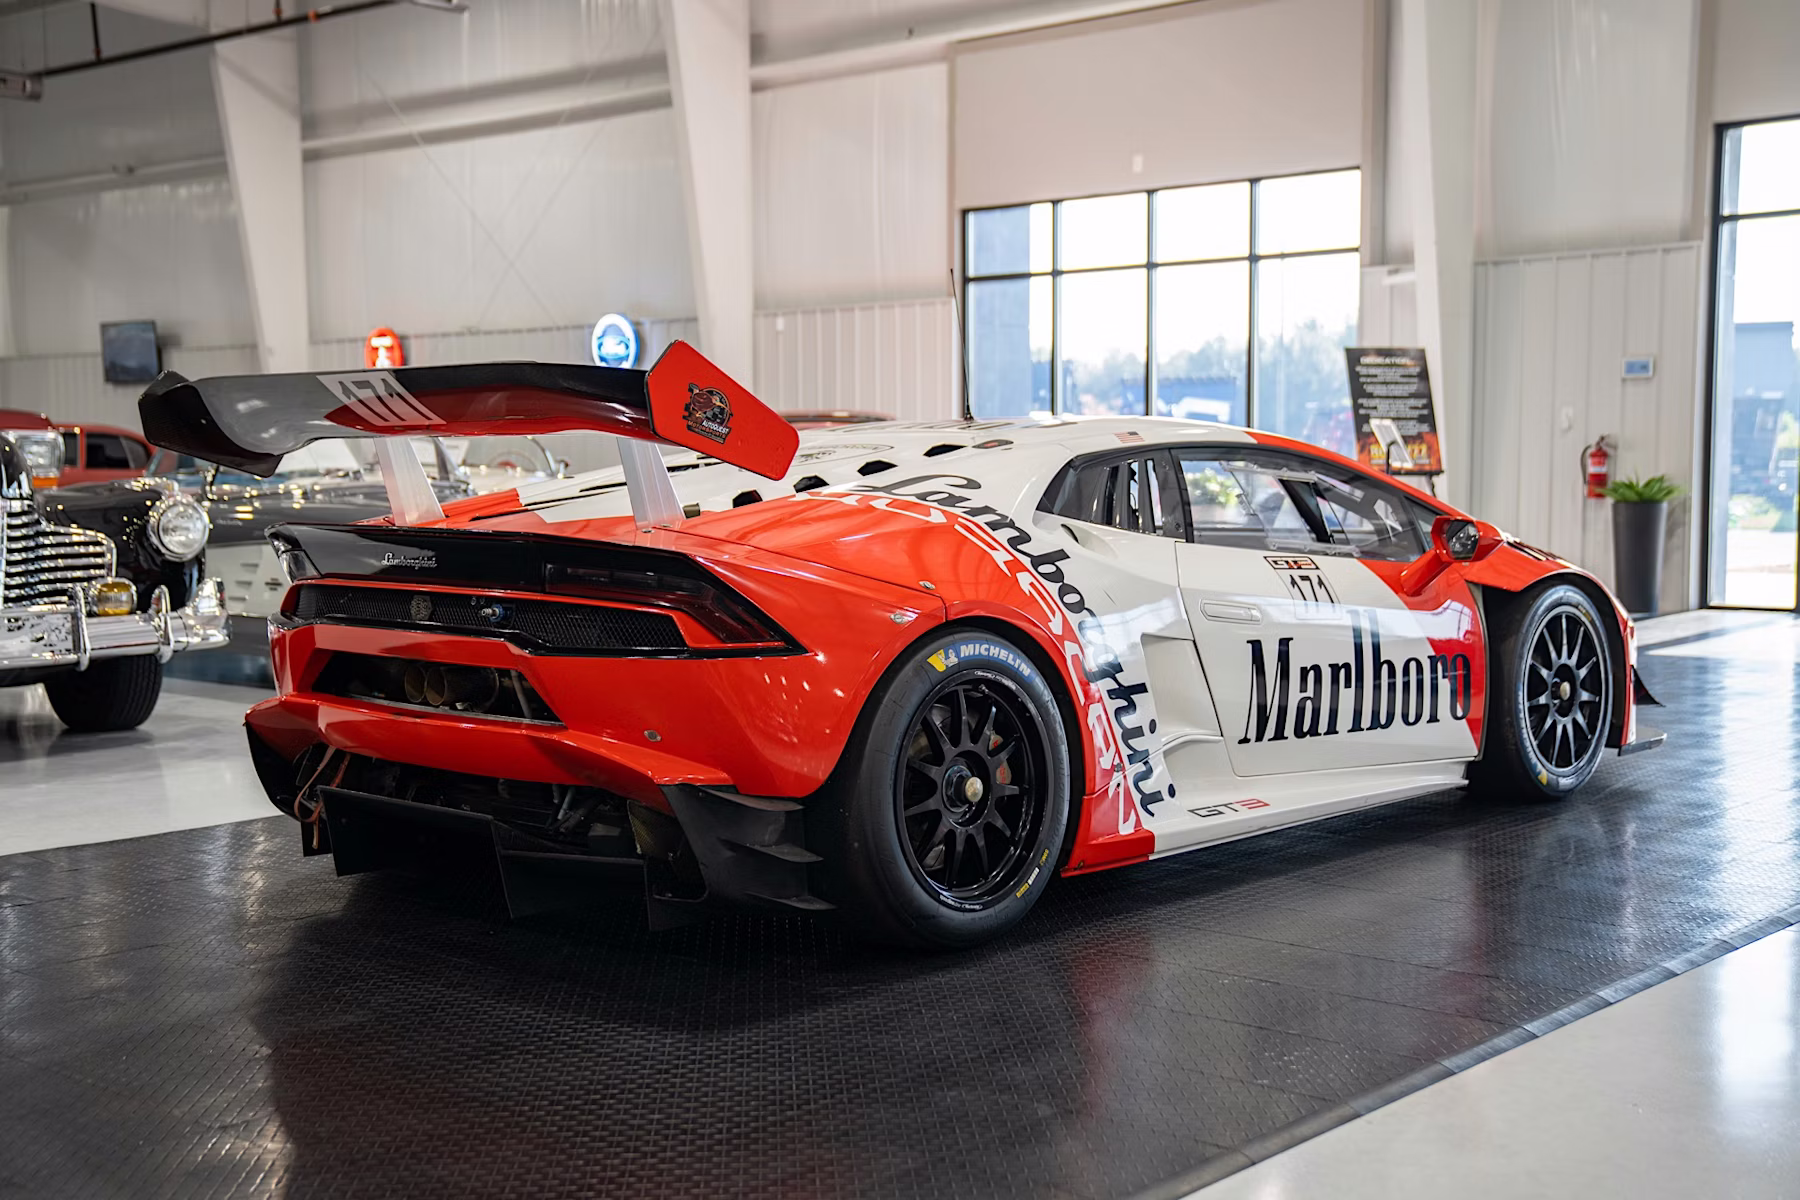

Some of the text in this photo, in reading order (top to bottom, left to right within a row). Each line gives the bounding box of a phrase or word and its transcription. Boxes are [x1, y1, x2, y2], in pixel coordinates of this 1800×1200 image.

[338, 378, 433, 422] 171
[381, 552, 438, 570] Lamborghini
[1289, 574, 1337, 613] 171
[848, 475, 1176, 818] Lamborghini
[959, 643, 1031, 677] MICHELIN
[1238, 609, 1471, 744] Marlboro
[1187, 798, 1271, 818] GT3
